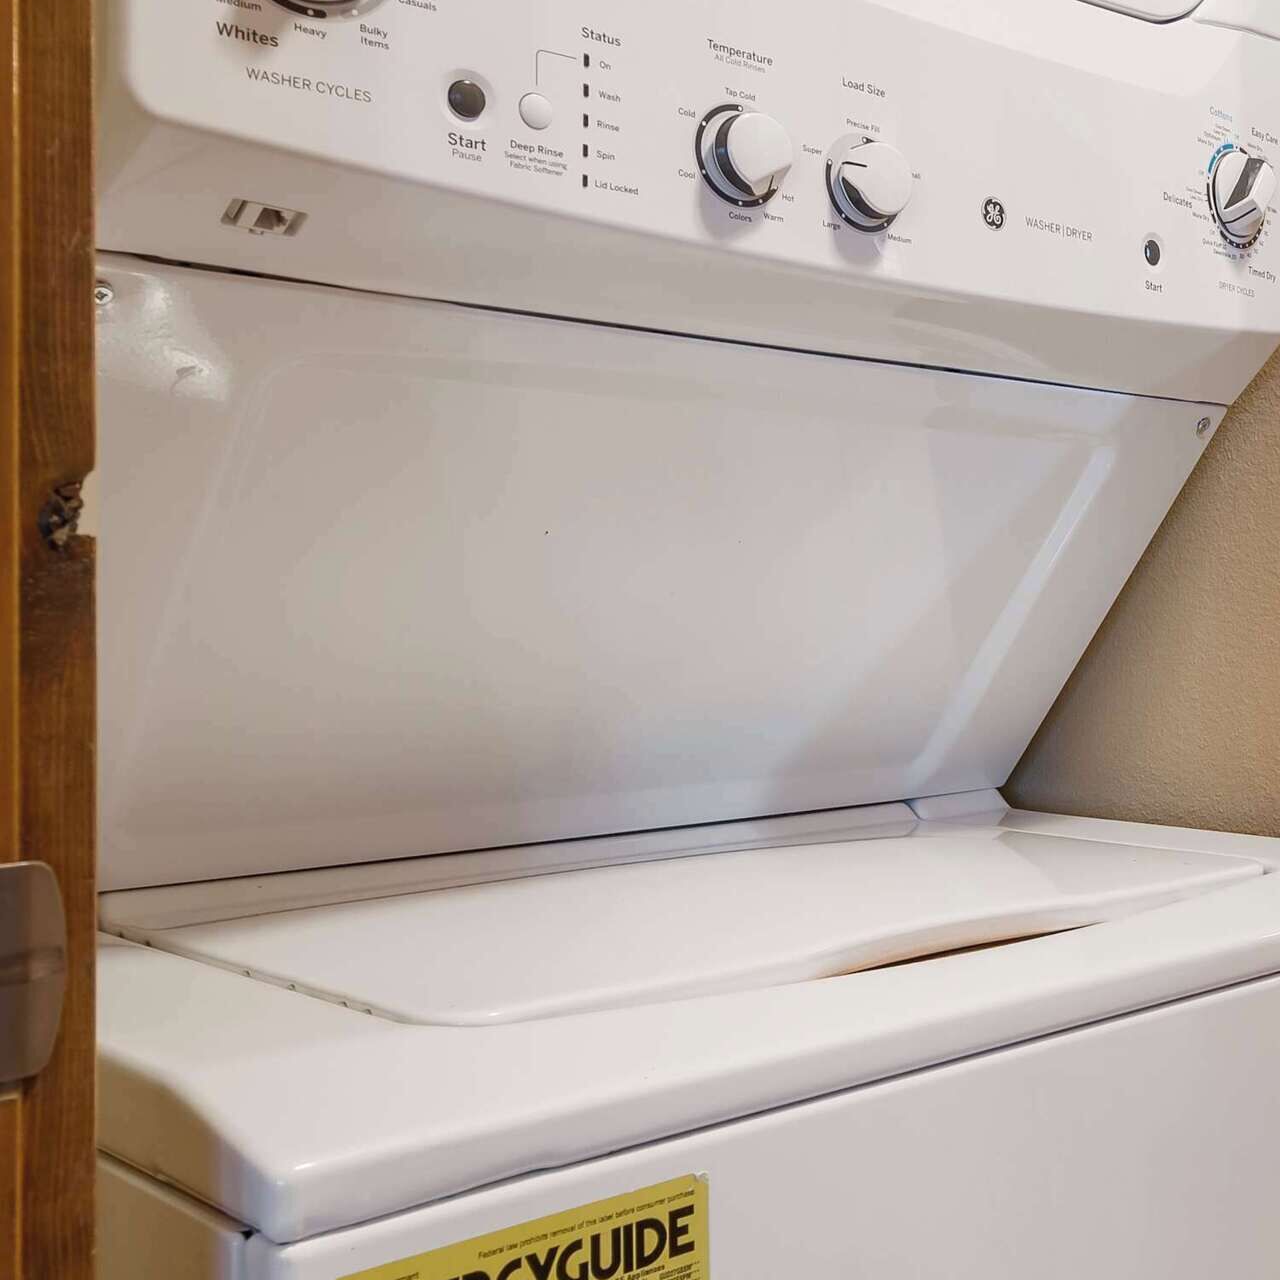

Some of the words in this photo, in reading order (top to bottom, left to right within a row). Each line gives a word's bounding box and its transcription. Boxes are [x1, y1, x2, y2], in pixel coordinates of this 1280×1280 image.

[216, 21, 279, 48] Whites
[294, 23, 327, 39] Heavy
[360, 24, 388, 39] Bulky
[582, 27, 621, 47] Status
[360, 36, 390, 50] Items
[707, 39, 773, 66] Temperature
[599, 61, 611, 70] On
[246, 67, 311, 91] WASHER
[316, 82, 372, 103] CYCLES
[842, 78, 864, 92] Load
[867, 85, 886, 98] Size
[599, 91, 621, 102] Wash
[725, 88, 737, 98] Tap
[739, 92, 756, 101] Cold
[678, 108, 696, 118] Cold
[597, 120, 620, 132] Rinse
[847, 119, 869, 131] Precise
[871, 124, 880, 133] Fill
[448, 132, 486, 151] Start
[452, 149, 482, 162] Pause
[510, 140, 535, 154] Deep
[537, 145, 564, 158] Rinse
[597, 150, 615, 161] Spin
[803, 144, 822, 155] Super
[678, 169, 696, 179] Cool
[595, 180, 607, 190] Lid
[610, 183, 639, 195] Locked
[782, 193, 794, 202] Hot
[1163, 192, 1192, 210] Delicates
[729, 212, 752, 222] Colors
[763, 213, 784, 222] Warm
[822, 220, 841, 231] Large
[888, 234, 912, 244] Medium
[1145, 281, 1162, 292] Start
